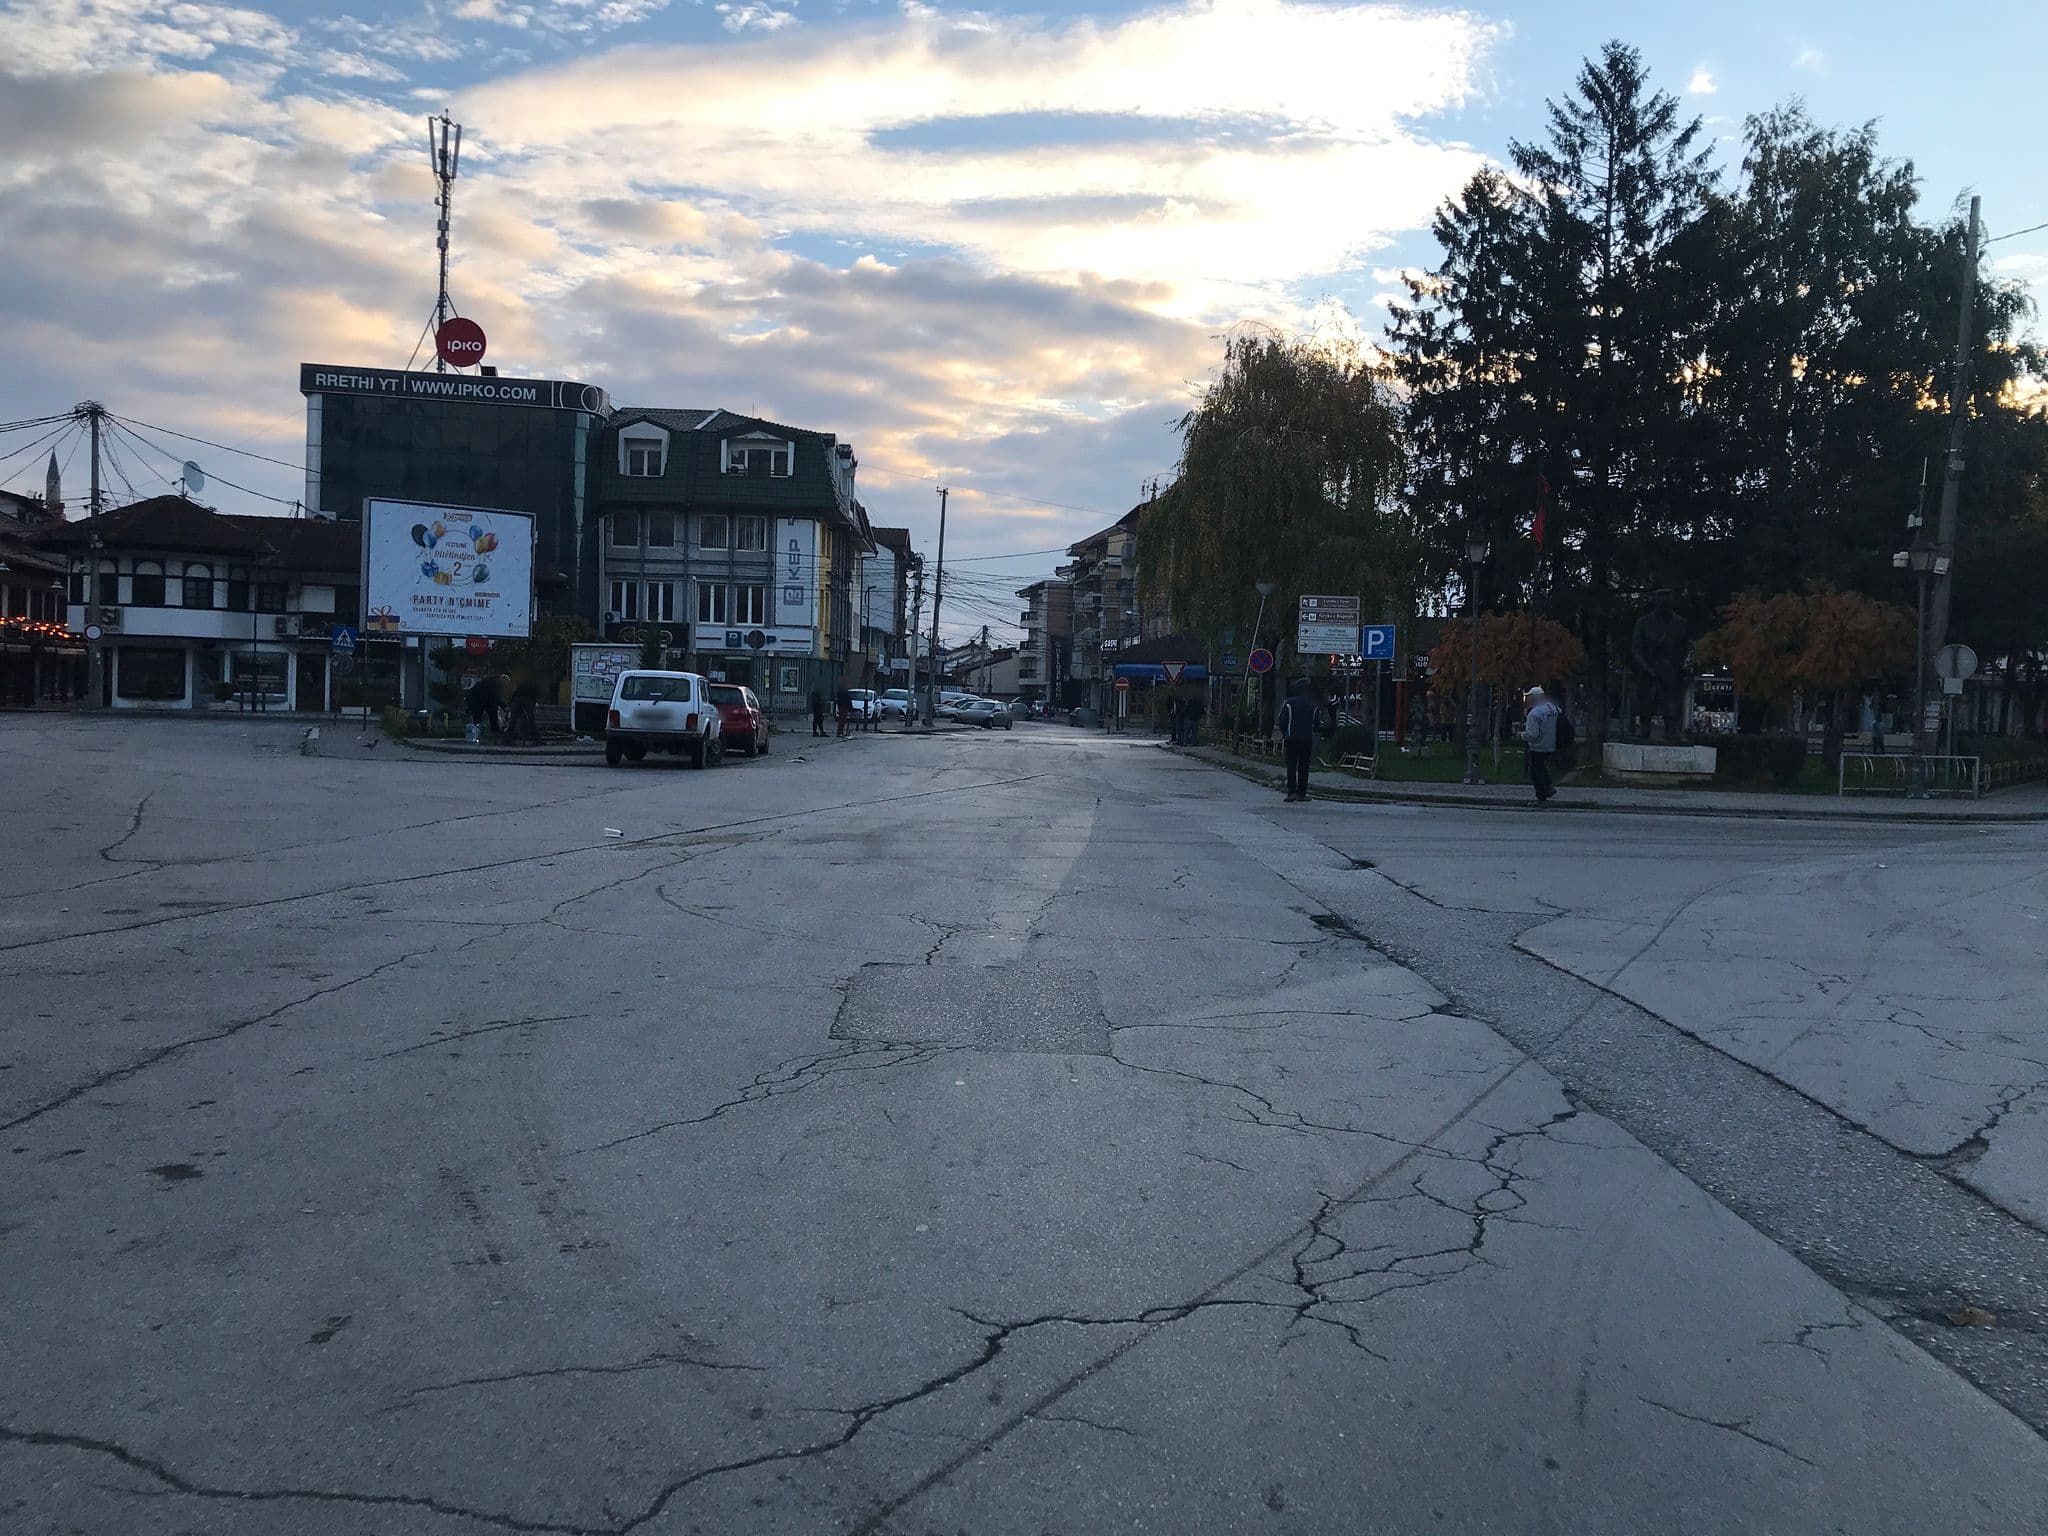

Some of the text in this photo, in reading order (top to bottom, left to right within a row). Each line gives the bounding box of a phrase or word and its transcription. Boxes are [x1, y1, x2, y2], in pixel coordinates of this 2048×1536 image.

[315, 373, 536, 400] RRETHI YT WWW.IPKO.COM
[453, 562, 462, 576] 2
[413, 595, 444, 605] PARTY
[1367, 630, 1384, 654] P
